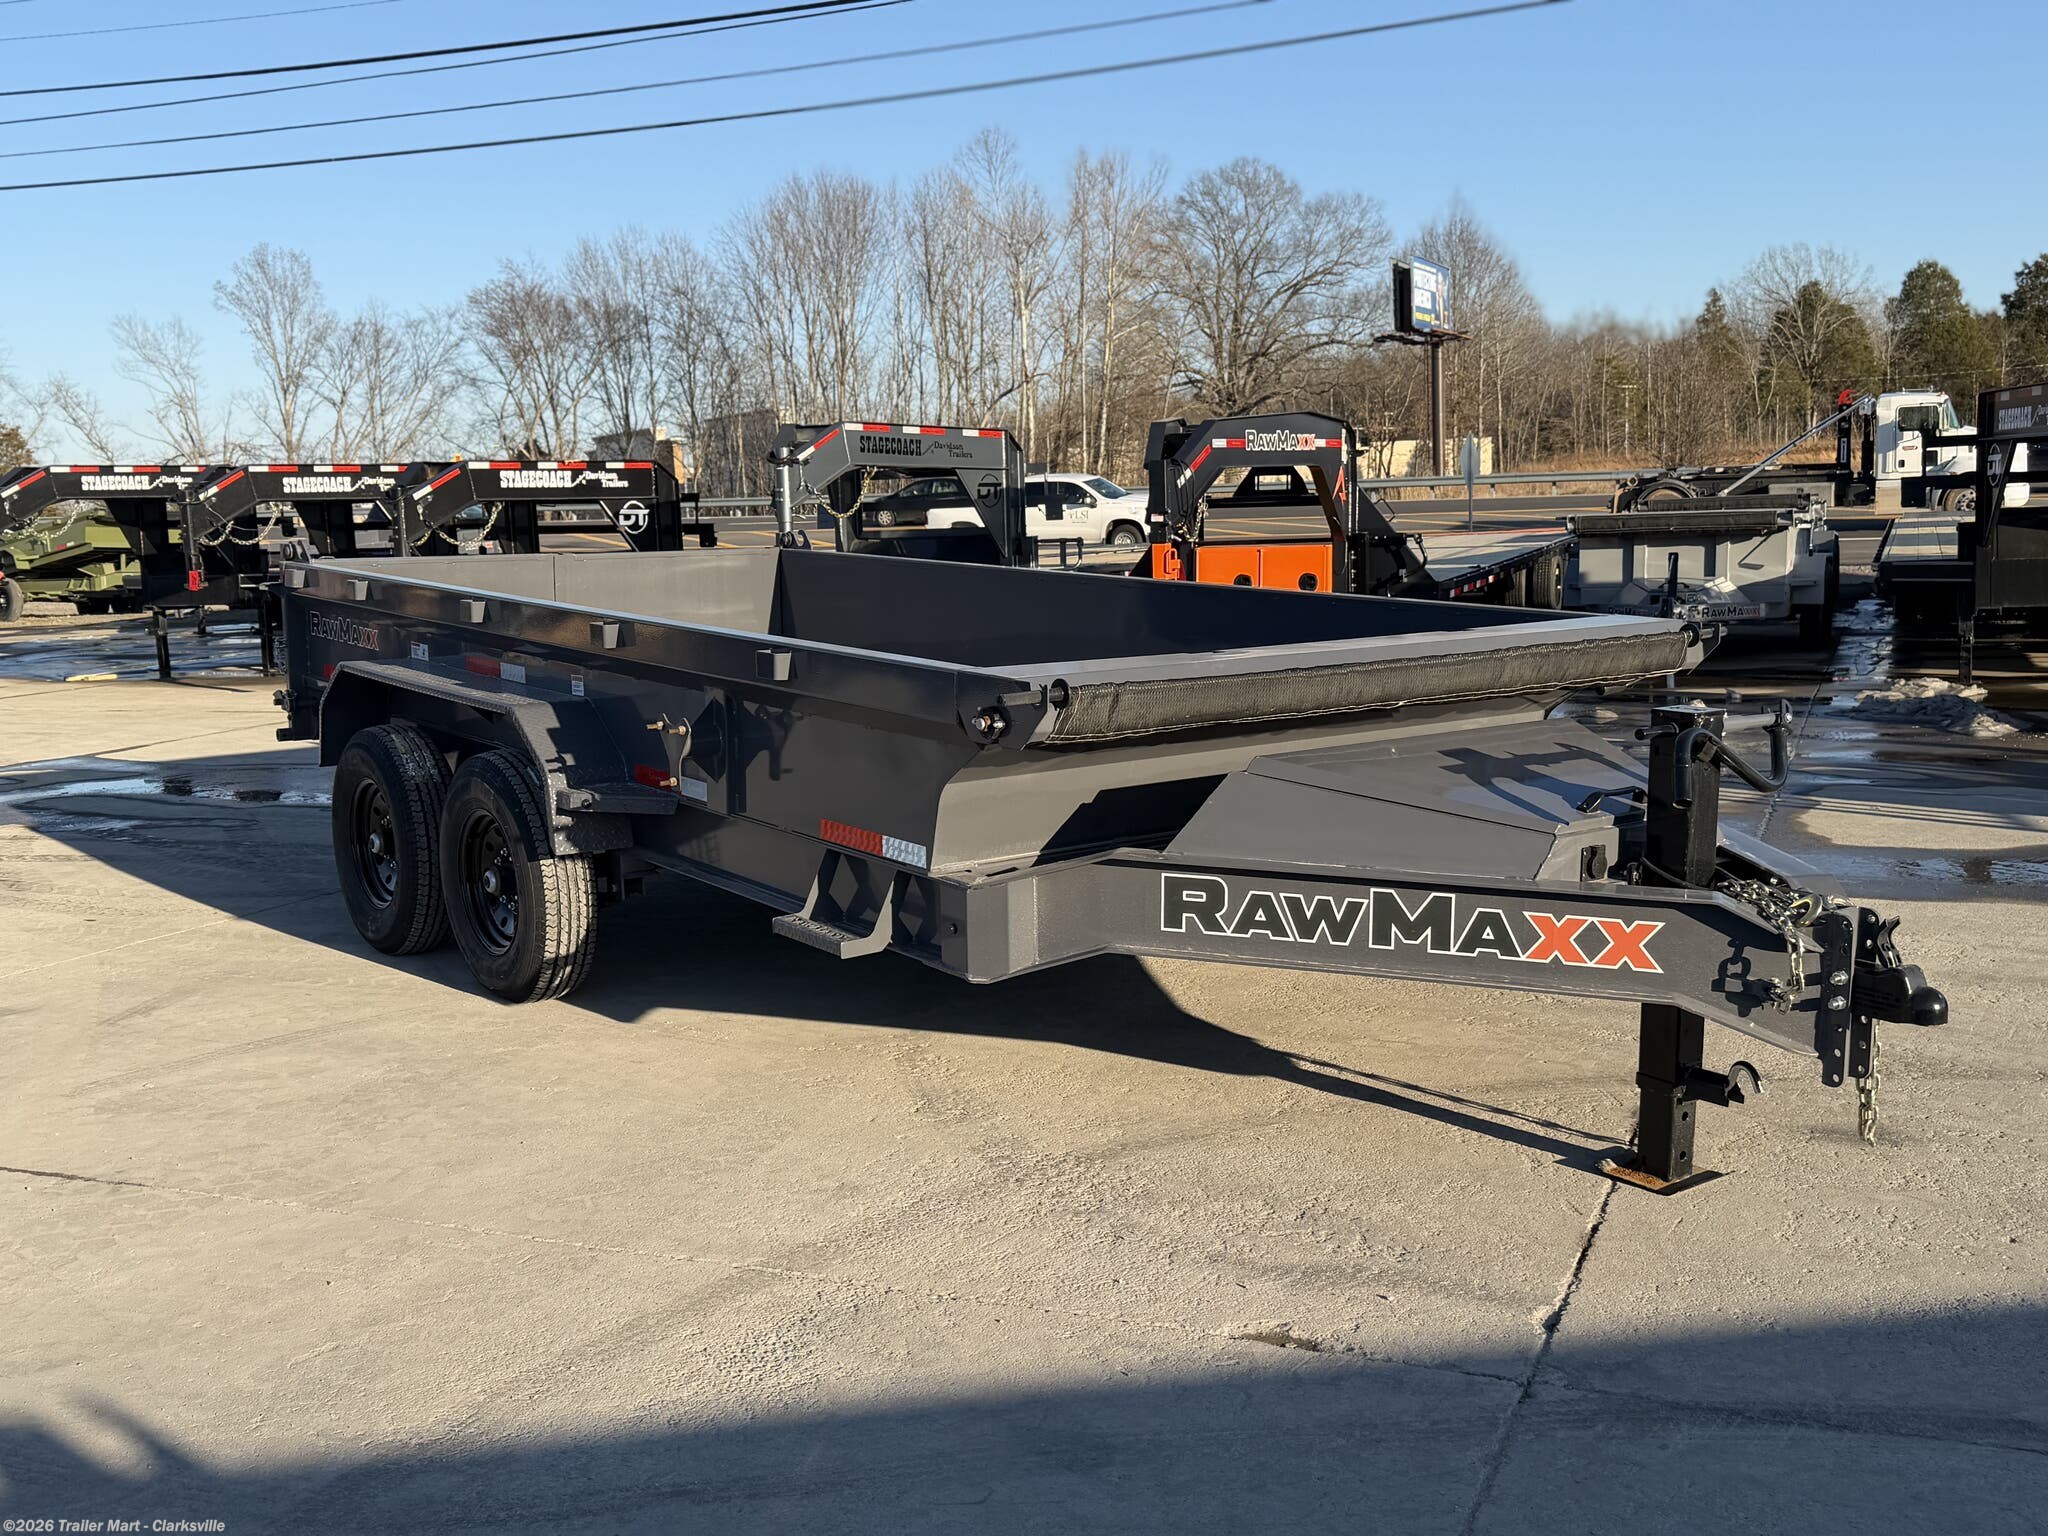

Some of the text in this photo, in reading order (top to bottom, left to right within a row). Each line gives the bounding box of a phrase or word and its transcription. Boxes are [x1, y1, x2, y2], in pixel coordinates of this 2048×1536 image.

[859, 435, 922, 457] STAGECOACH
[81, 475, 150, 491] STAGECOACH
[282, 476, 351, 493] STAGECOACH
[500, 470, 572, 489] STAGECOACH
[584, 471, 618, 481] Davidson
[602, 479, 628, 488] Trailers
[1161, 872, 1666, 974] RAWMAXX
